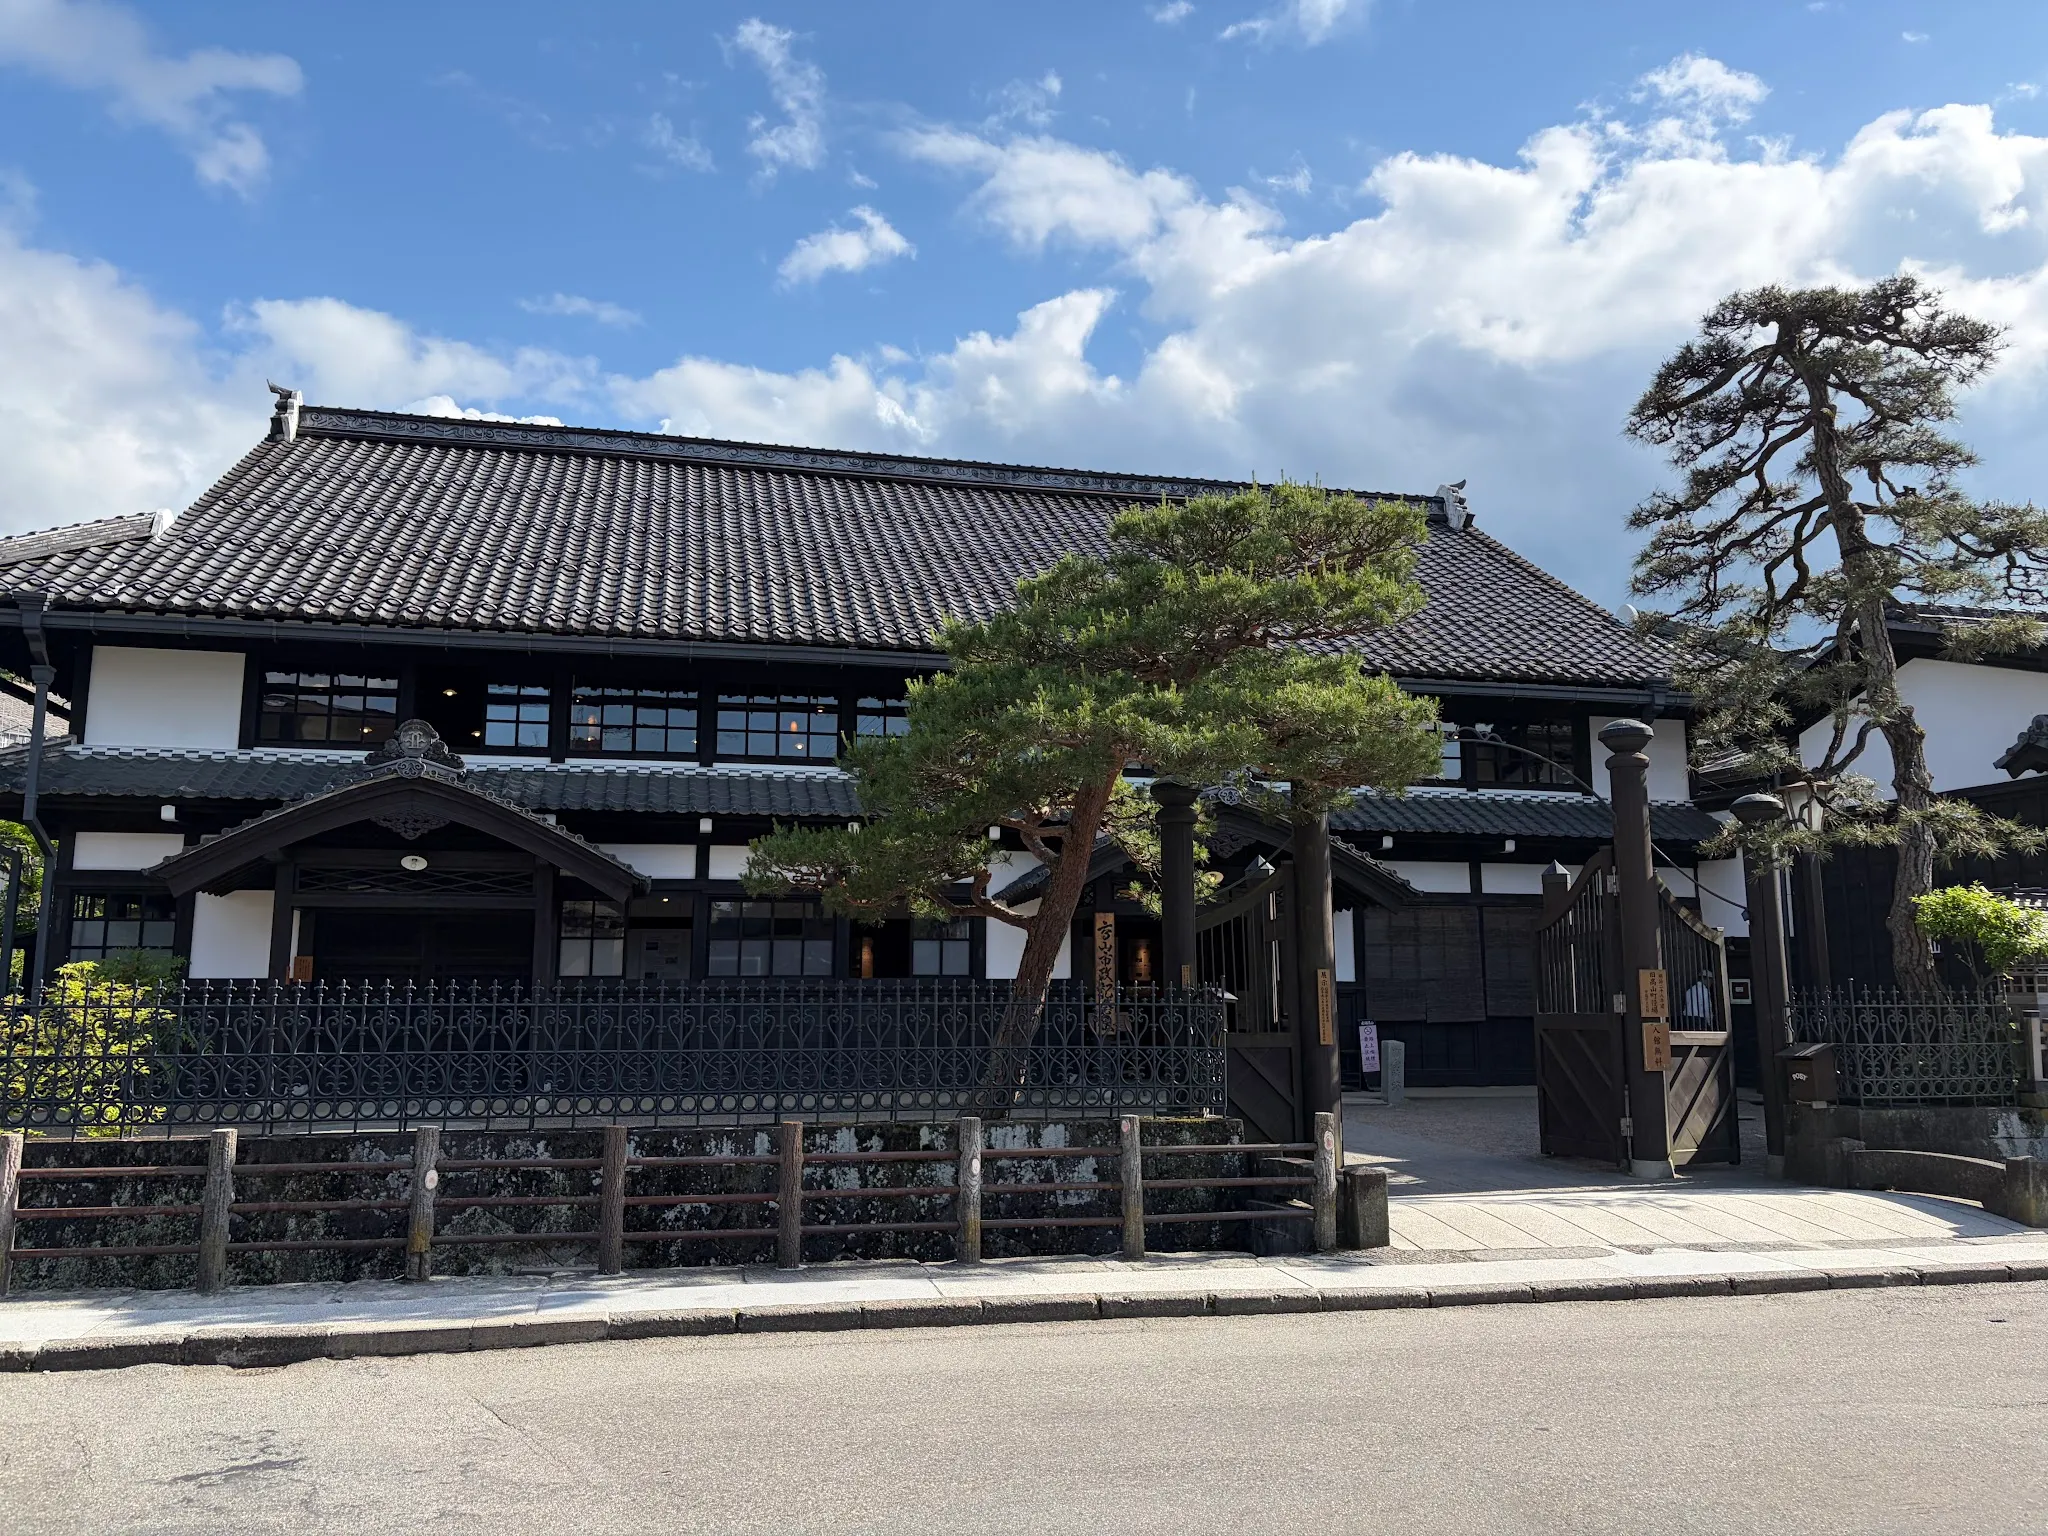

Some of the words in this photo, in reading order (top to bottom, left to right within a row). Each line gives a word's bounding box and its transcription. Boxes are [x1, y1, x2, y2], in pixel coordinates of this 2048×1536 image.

[1653, 1027, 1662, 1067] 入館無料
[1792, 1072, 1808, 1081] POST
